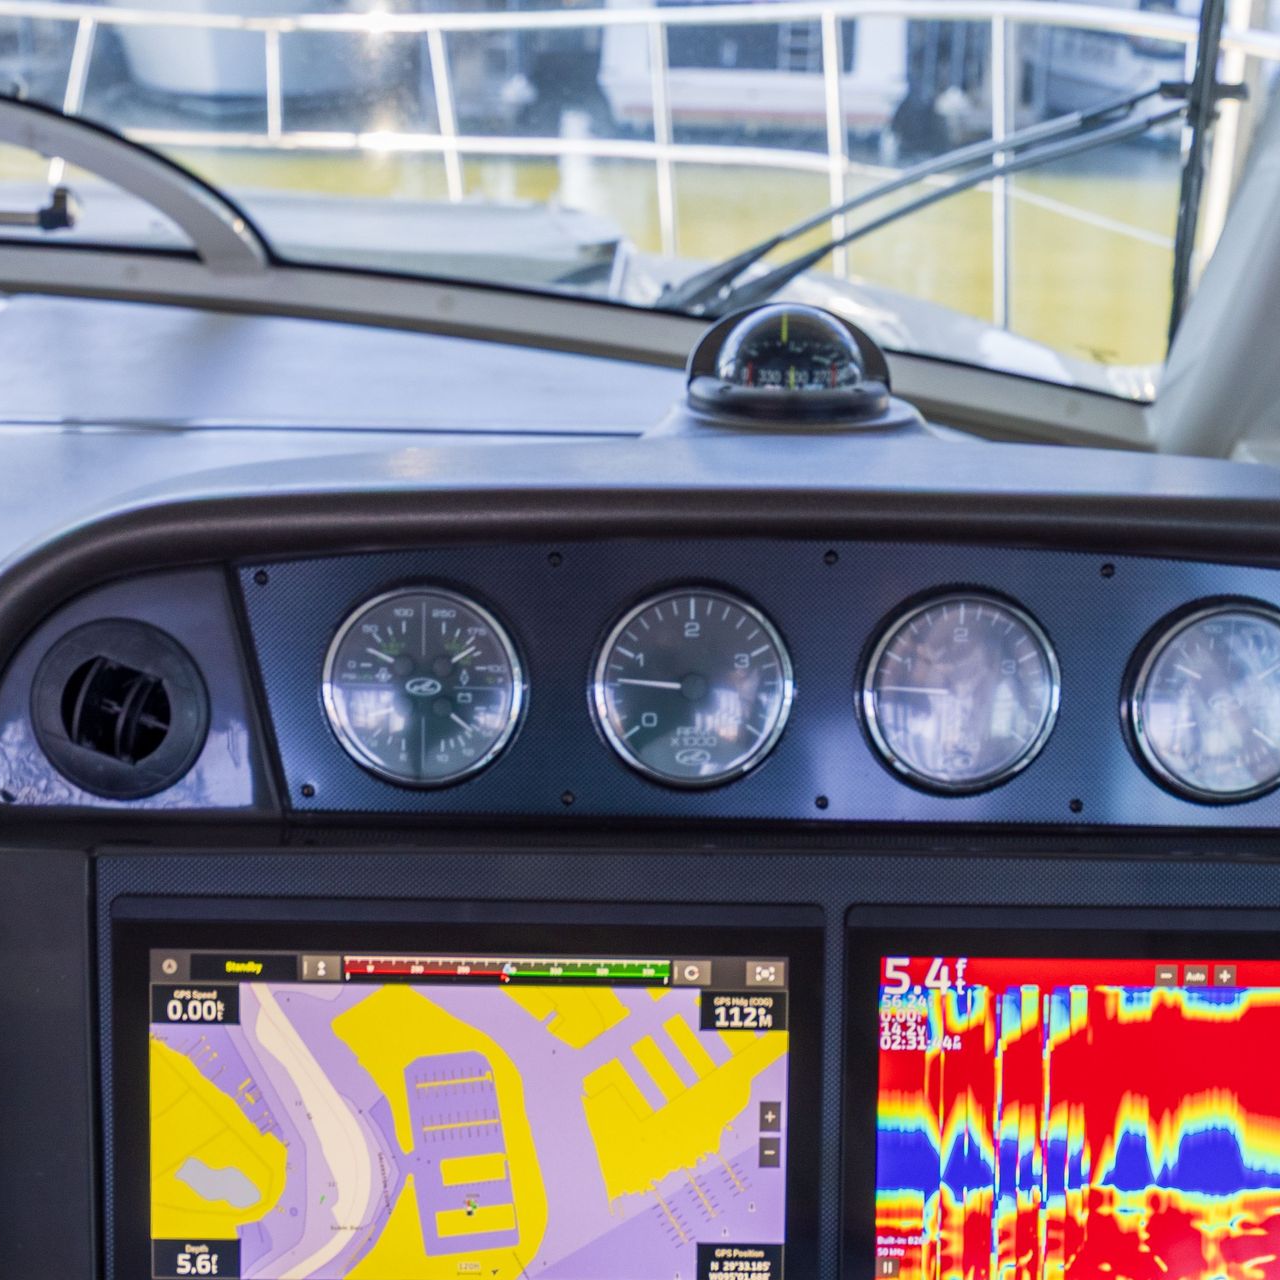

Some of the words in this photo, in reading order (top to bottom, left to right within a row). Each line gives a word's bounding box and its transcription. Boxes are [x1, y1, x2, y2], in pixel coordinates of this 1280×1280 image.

[684, 622, 700, 637] 2
[953, 627, 969, 642] 2
[635, 653, 645, 667] 1
[734, 654, 750, 668] 3
[904, 657, 912, 672] 1
[1001, 660, 1016, 674] 3
[641, 712, 658, 727] 0
[225, 961, 263, 974] Standby
[883, 957, 952, 995] 5.4
[1186, 971, 1205, 982] Auto
[173, 990, 192, 1000] GPS
[193, 990, 218, 1001] Speed
[714, 996, 732, 1007] GPS
[167, 1000, 217, 1021] 0.00
[715, 1007, 757, 1027] 112
[185, 1244, 209, 1255] Depth
[715, 1249, 732, 1258] GPS
[733, 1249, 765, 1258] Position
[176, 1254, 210, 1275] 5.6
